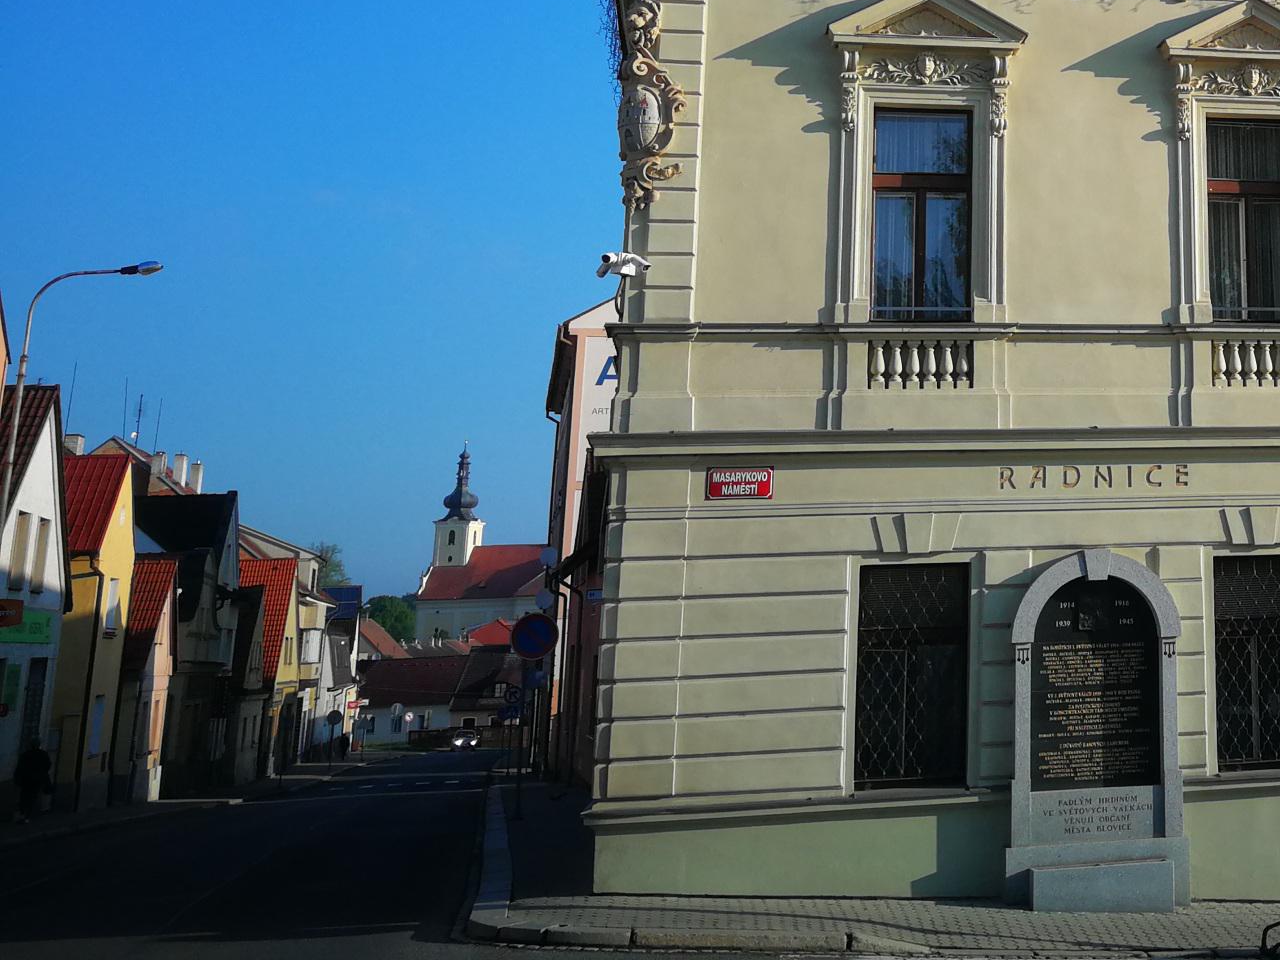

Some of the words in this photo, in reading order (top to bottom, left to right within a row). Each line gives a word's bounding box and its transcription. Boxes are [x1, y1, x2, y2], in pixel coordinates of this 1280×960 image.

[712, 471, 768, 483] MASARYKOVO
[999, 464, 1189, 490] RADNICE
[721, 482, 758, 496] NÁMĚSTÍ
[1059, 601, 1075, 609] 1914
[1055, 620, 1071, 628] 1939
[1058, 796, 1092, 807] PADLÝM
[1098, 793, 1138, 805] HRDINŮM
[1042, 809, 1055, 817] VE
[1064, 825, 1091, 835] MĚSTA
[1096, 823, 1132, 833] BLOVICE
